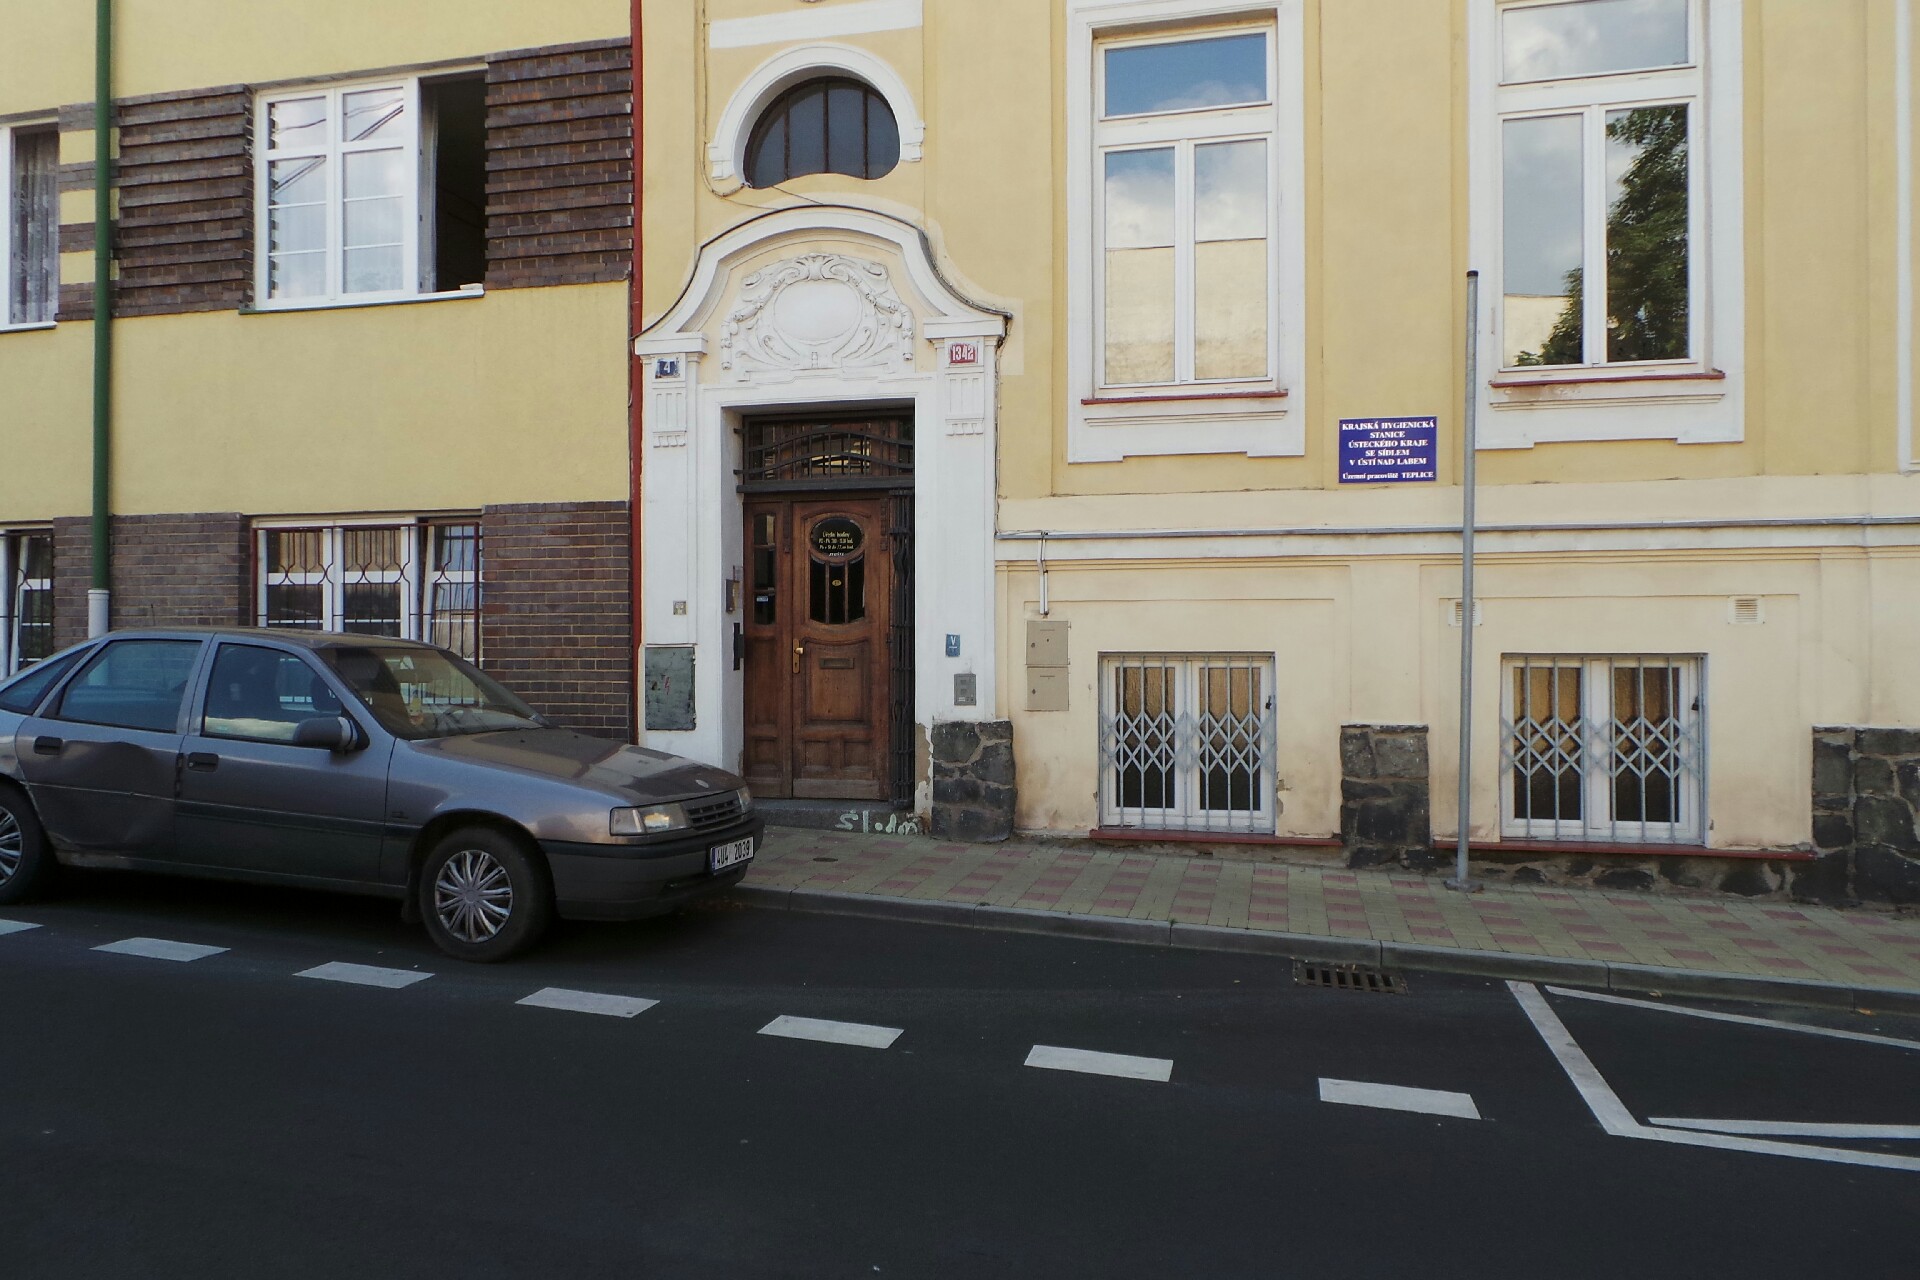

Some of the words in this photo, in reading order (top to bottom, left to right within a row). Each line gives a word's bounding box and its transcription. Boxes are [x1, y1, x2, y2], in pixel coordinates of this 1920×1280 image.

[952, 344, 974, 361] 1342
[663, 361, 671, 373] 4
[1342, 421, 1379, 431] KRAJSKÁ
[1381, 420, 1435, 429] HYGIENICKÁ
[1369, 431, 1405, 439] STANICE
[1348, 439, 1398, 448] ÚSTECKÉHO
[1400, 439, 1428, 447] KRAJE
[1357, 457, 1376, 466] ÚSTÍ
[1377, 458, 1395, 466] NAD
[1342, 472, 1367, 480] Územní
[1402, 471, 1434, 479] TEPLICE
[717, 845, 729, 866] 4U4
[734, 839, 750, 861] 2039
